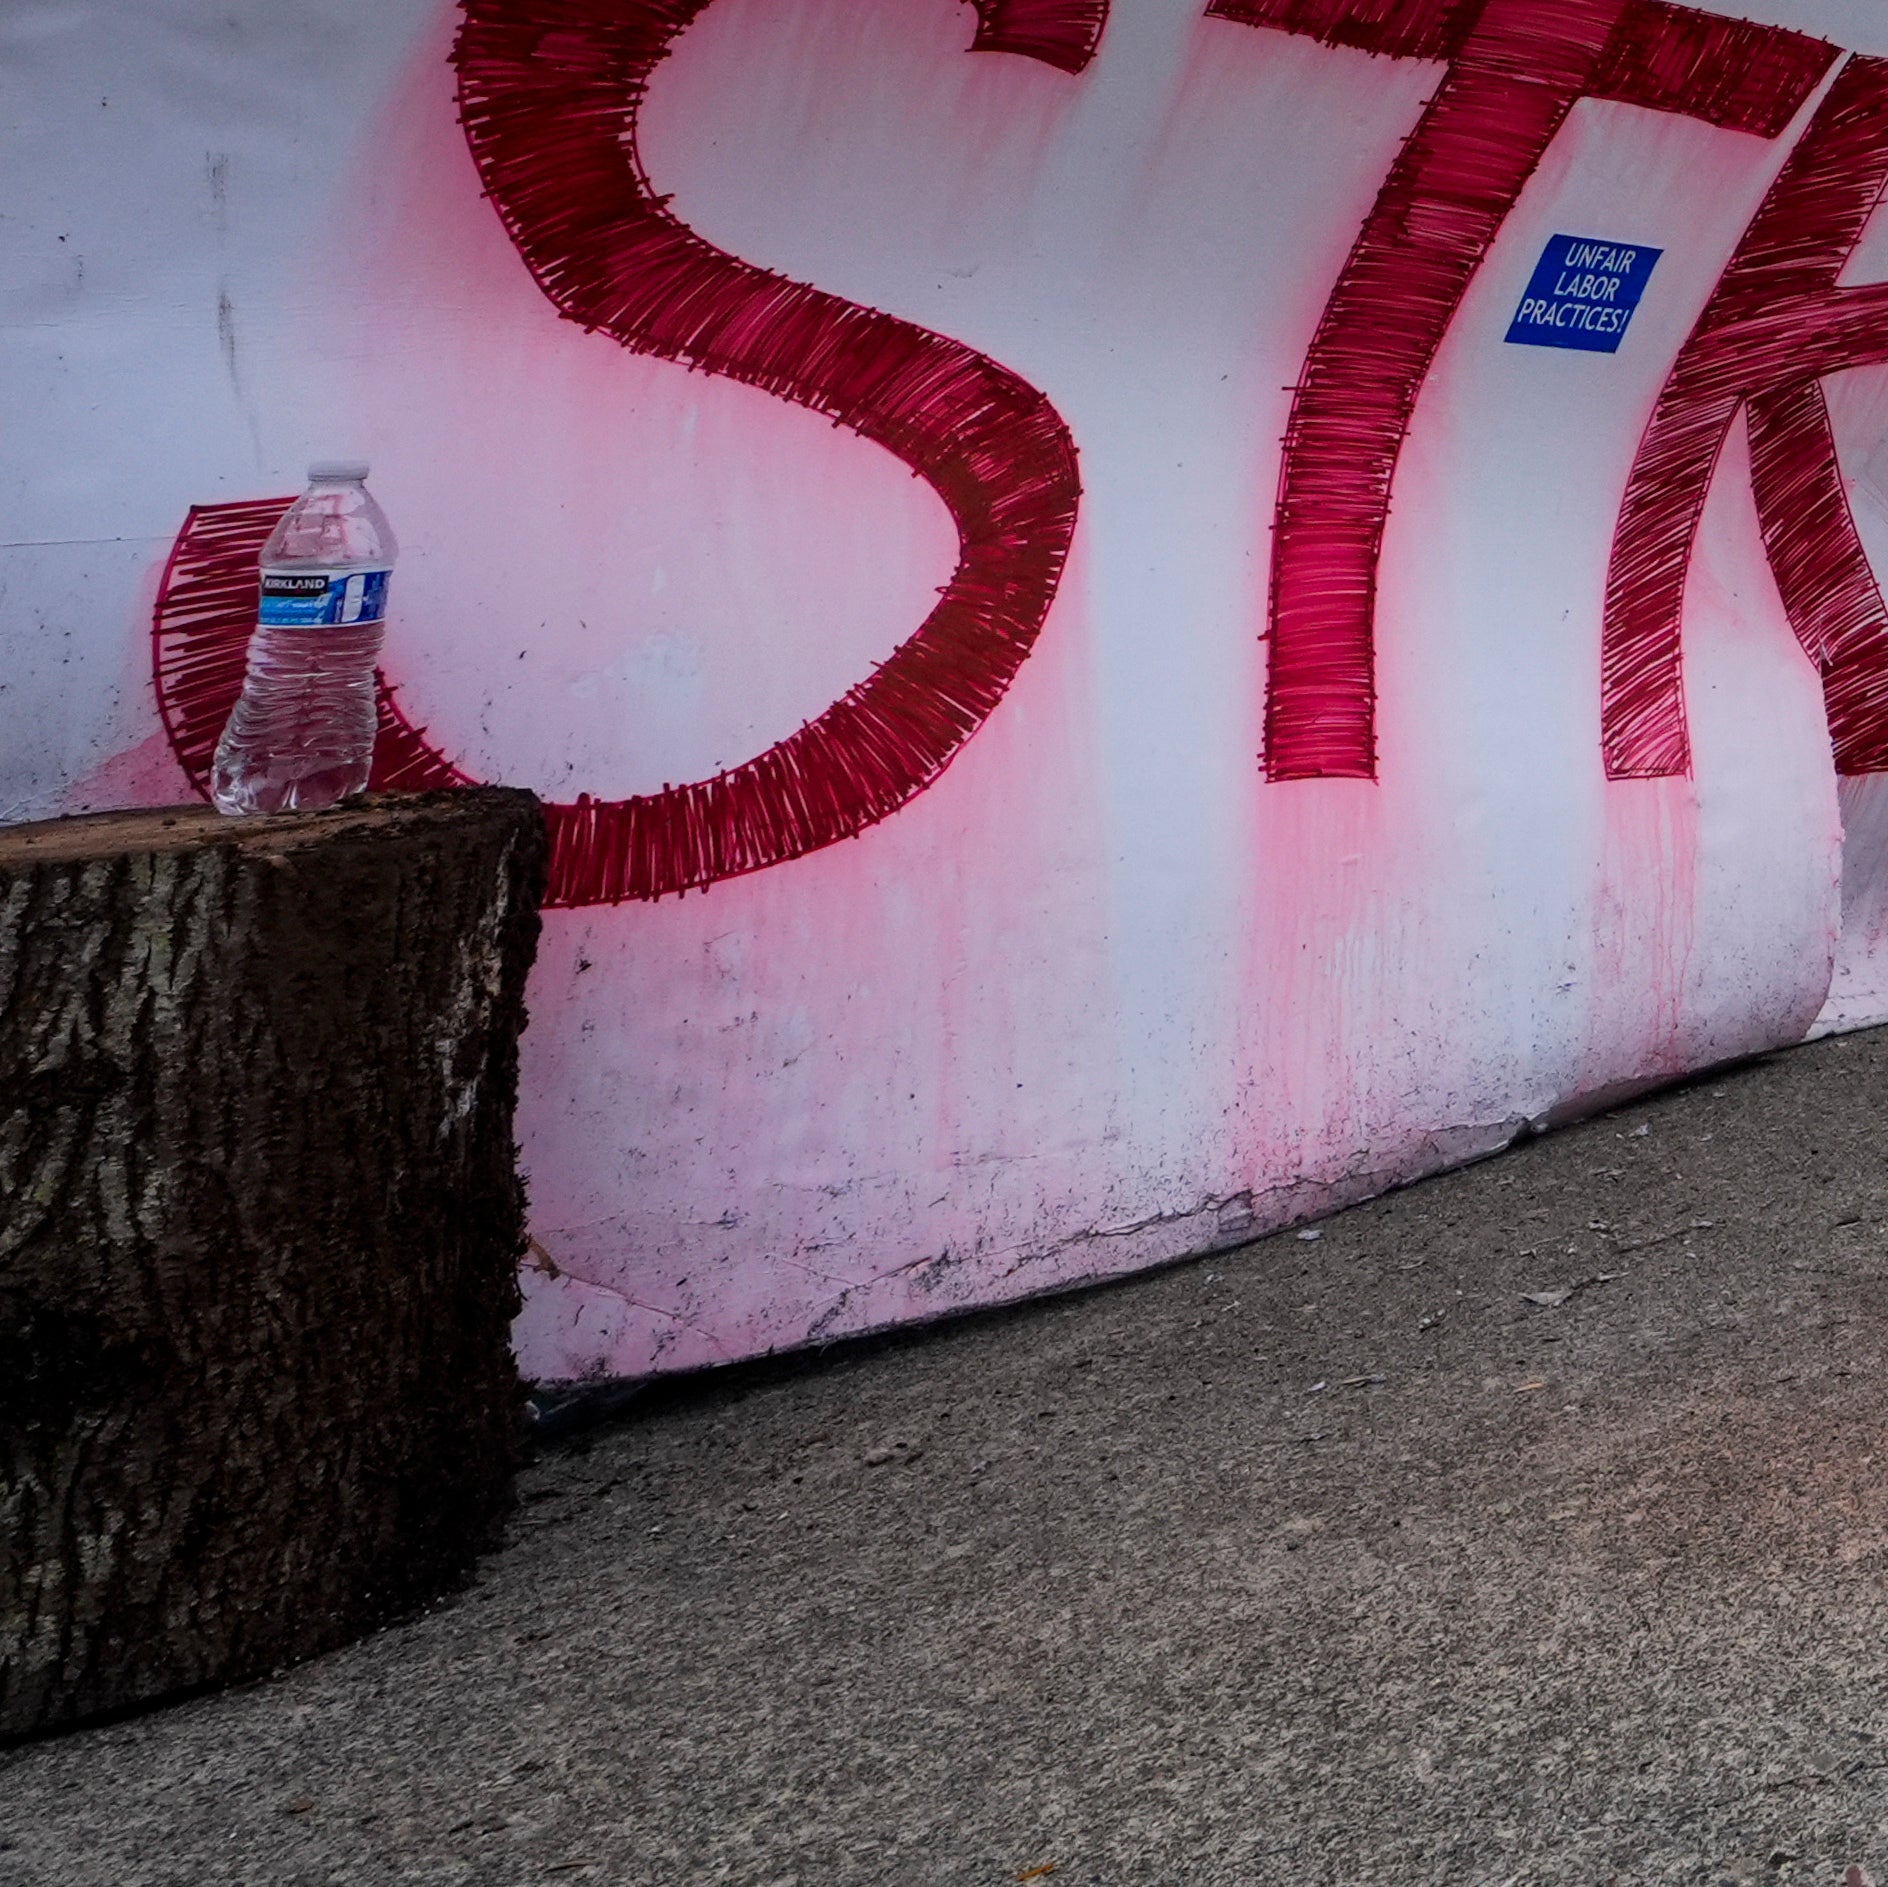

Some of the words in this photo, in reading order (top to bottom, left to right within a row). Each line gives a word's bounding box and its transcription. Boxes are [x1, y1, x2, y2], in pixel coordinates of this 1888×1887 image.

[1565, 242, 1636, 274] UNFAIR
[1553, 272, 1620, 301] LABOR
[1517, 298, 1629, 333] PRACTICES!
[264, 578, 326, 590] KIRKLAND
